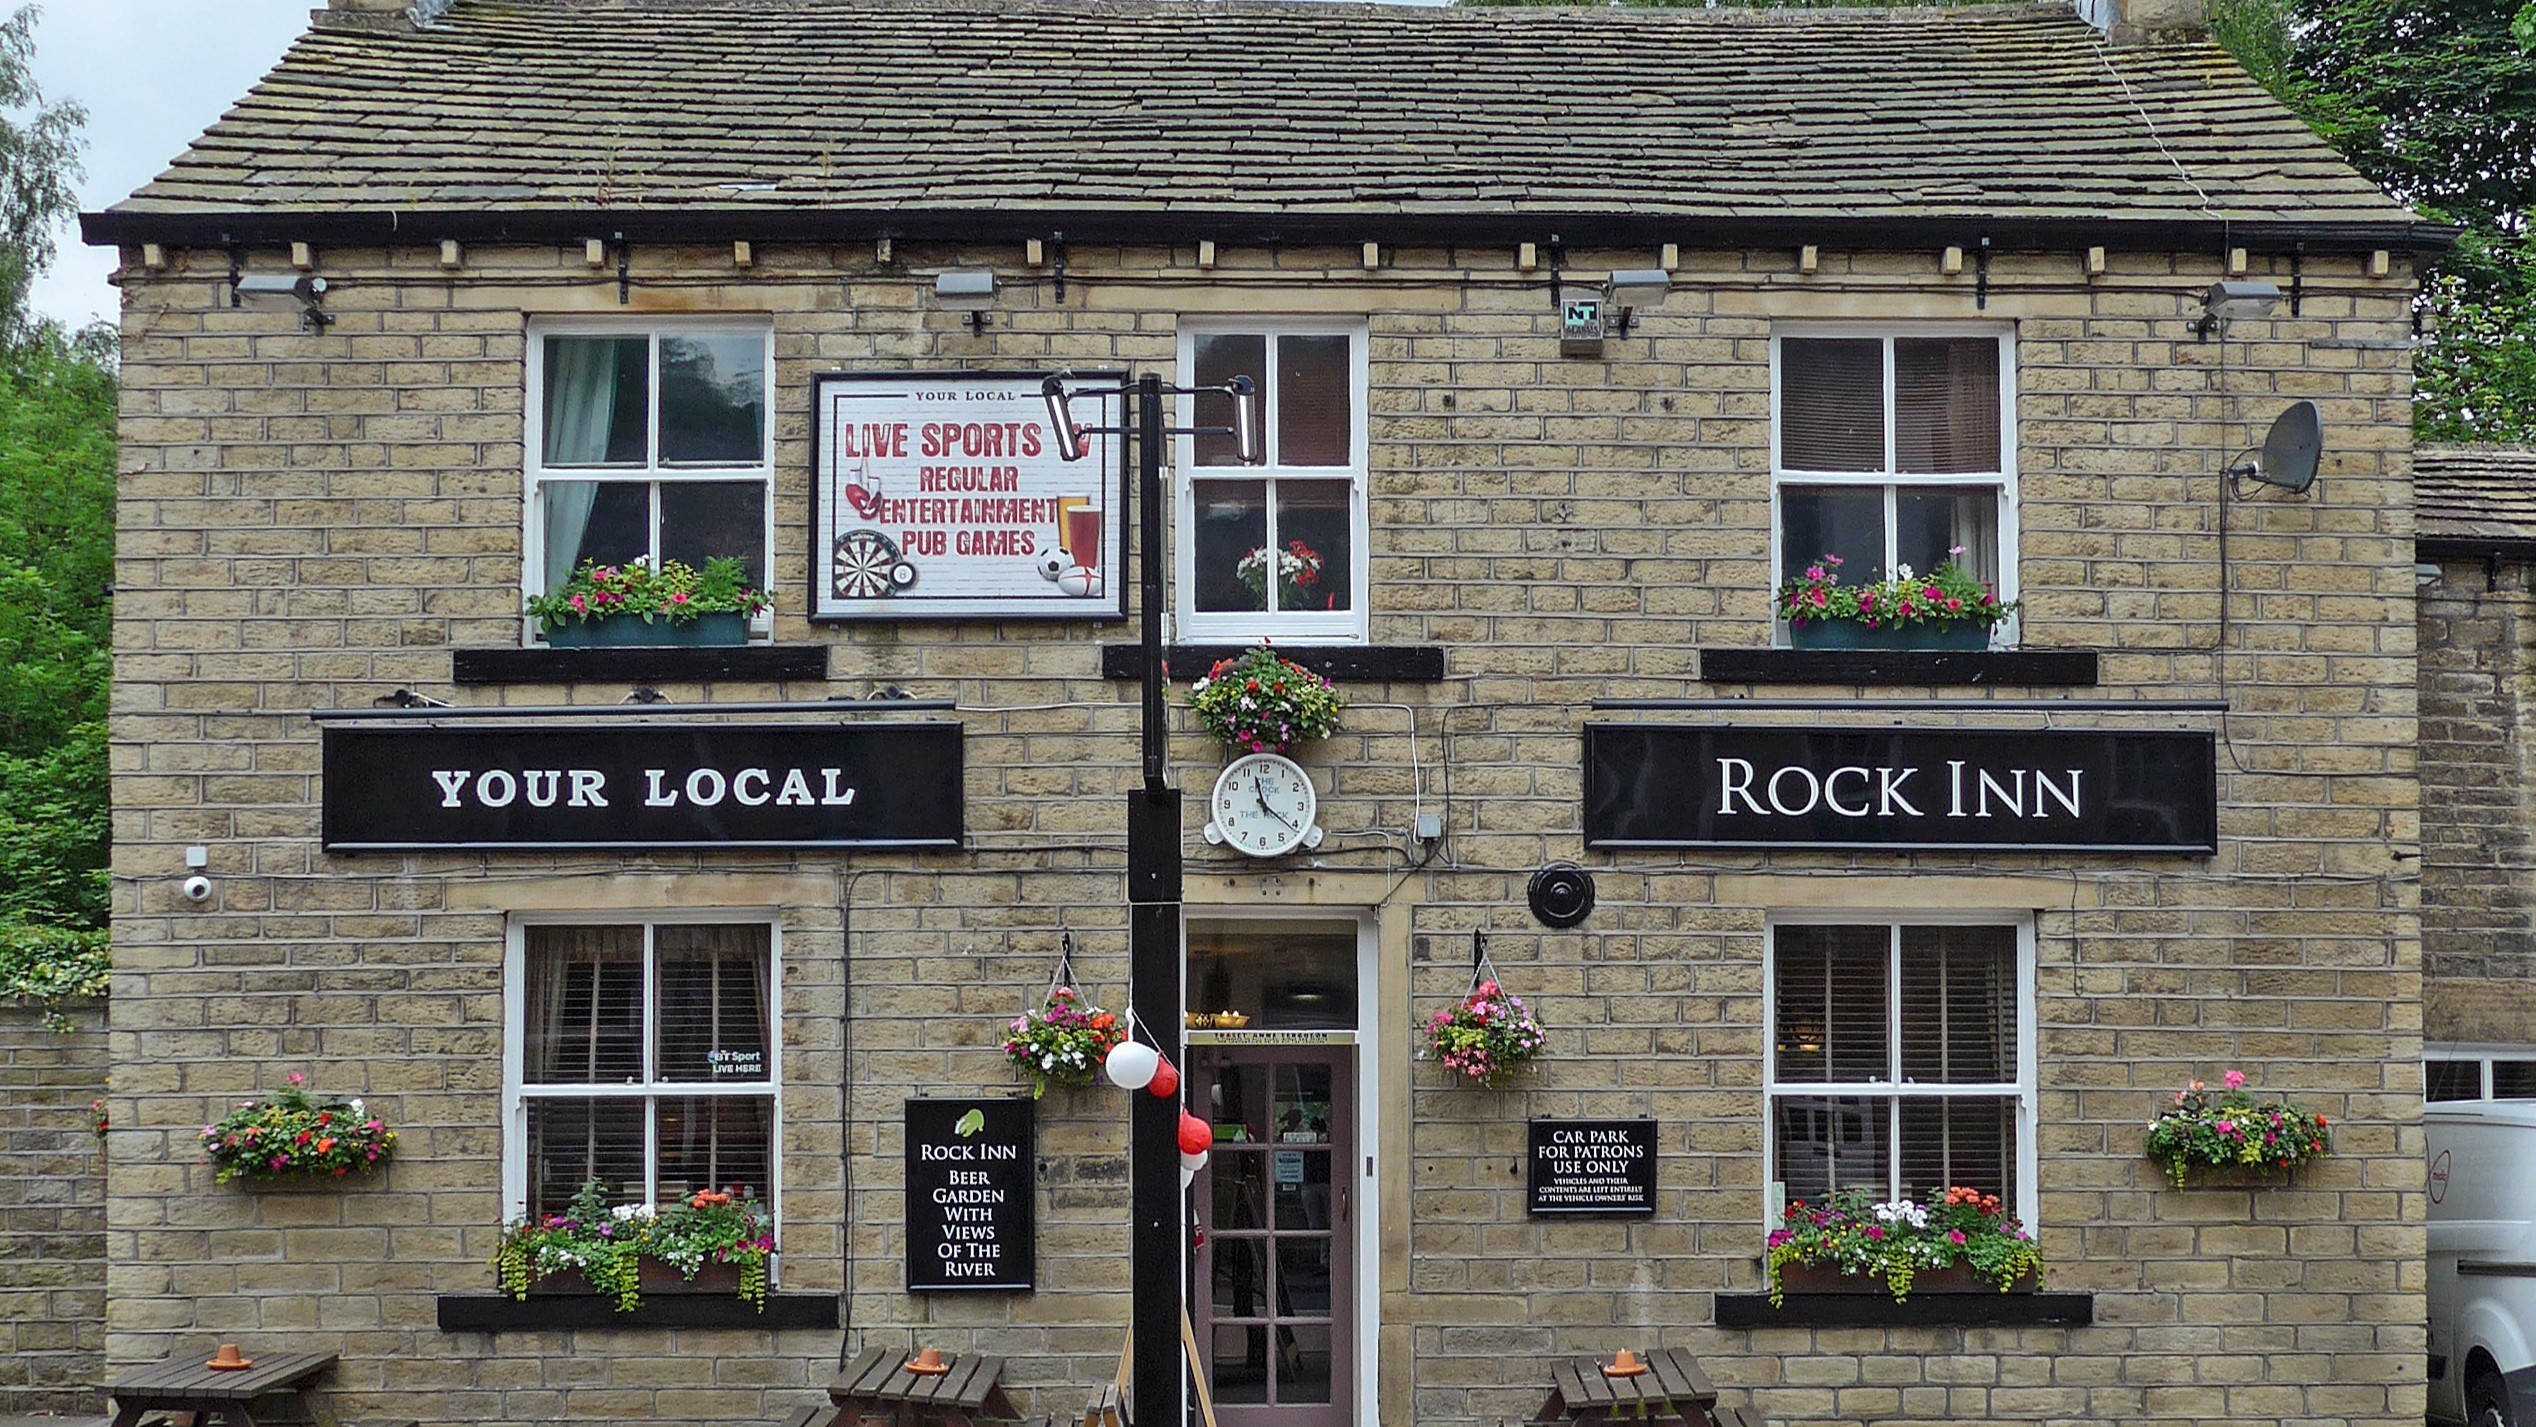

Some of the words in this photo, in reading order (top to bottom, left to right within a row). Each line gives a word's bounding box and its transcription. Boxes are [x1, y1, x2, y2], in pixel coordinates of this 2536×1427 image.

[916, 391, 957, 401] YOUR
[966, 391, 1015, 401] LOCAL
[846, 424, 908, 458] LIVE
[922, 423, 1042, 457] SPORTS
[920, 467, 1018, 492] REGULAR
[880, 498, 1056, 524] ENTERTAINMENT
[902, 531, 946, 556] PUB
[956, 531, 1035, 556] GAMES
[1243, 769, 1250, 778] 11
[1259, 764, 1270, 774] 12
[431, 769, 609, 808] YOUR
[644, 768, 856, 807] LOCAL
[1228, 782, 1239, 791] 10
[1292, 783, 1299, 793] 2
[1716, 758, 1925, 817] ROCK
[1946, 760, 2084, 818] INN
[1224, 800, 1231, 809] 9
[1297, 802, 1304, 811] 3
[1240, 810, 1258, 819] THE
[1228, 818, 1235, 826] 8
[1291, 820, 1298, 828] 4
[1241, 832, 1248, 841] 7
[1259, 837, 1266, 846] 6
[1278, 833, 1285, 841] 5
[731, 1051, 761, 1063] Sport
[712, 1064, 734, 1074] LIVE
[735, 1064, 762, 1073] HERE
[1553, 1130, 1585, 1144] CAR
[1590, 1130, 1629, 1144] PARK
[921, 1144, 976, 1161] ROCK
[980, 1143, 1017, 1160] INN
[1538, 1145, 1570, 1159] FOR
[1574, 1145, 1644, 1159] PATRONS
[1553, 1160, 1582, 1174] USE
[1586, 1160, 1629, 1174] ONLY
[949, 1170, 991, 1186] BEER
[1553, 1177, 1588, 1185] VEHICLES
[1588, 1177, 1605, 1185] AND
[1606, 1177, 1629, 1185] THEIR
[1538, 1186, 1577, 1194] CONTENTS
[1610, 1185, 1643, 1193] ENTIRELY
[932, 1188, 1005, 1204] GARDEN
[1538, 1194, 1548, 1202] AT
[1549, 1194, 1563, 1202] THE
[1564, 1194, 1594, 1202] VEHICLE
[1627, 1194, 1644, 1202] RISK
[943, 1206, 993, 1222] WITH
[941, 1224, 995, 1240] VIEWS
[937, 1243, 962, 1259] OF
[965, 1242, 1001, 1258] THE
[945, 1261, 996, 1277] RIVER
